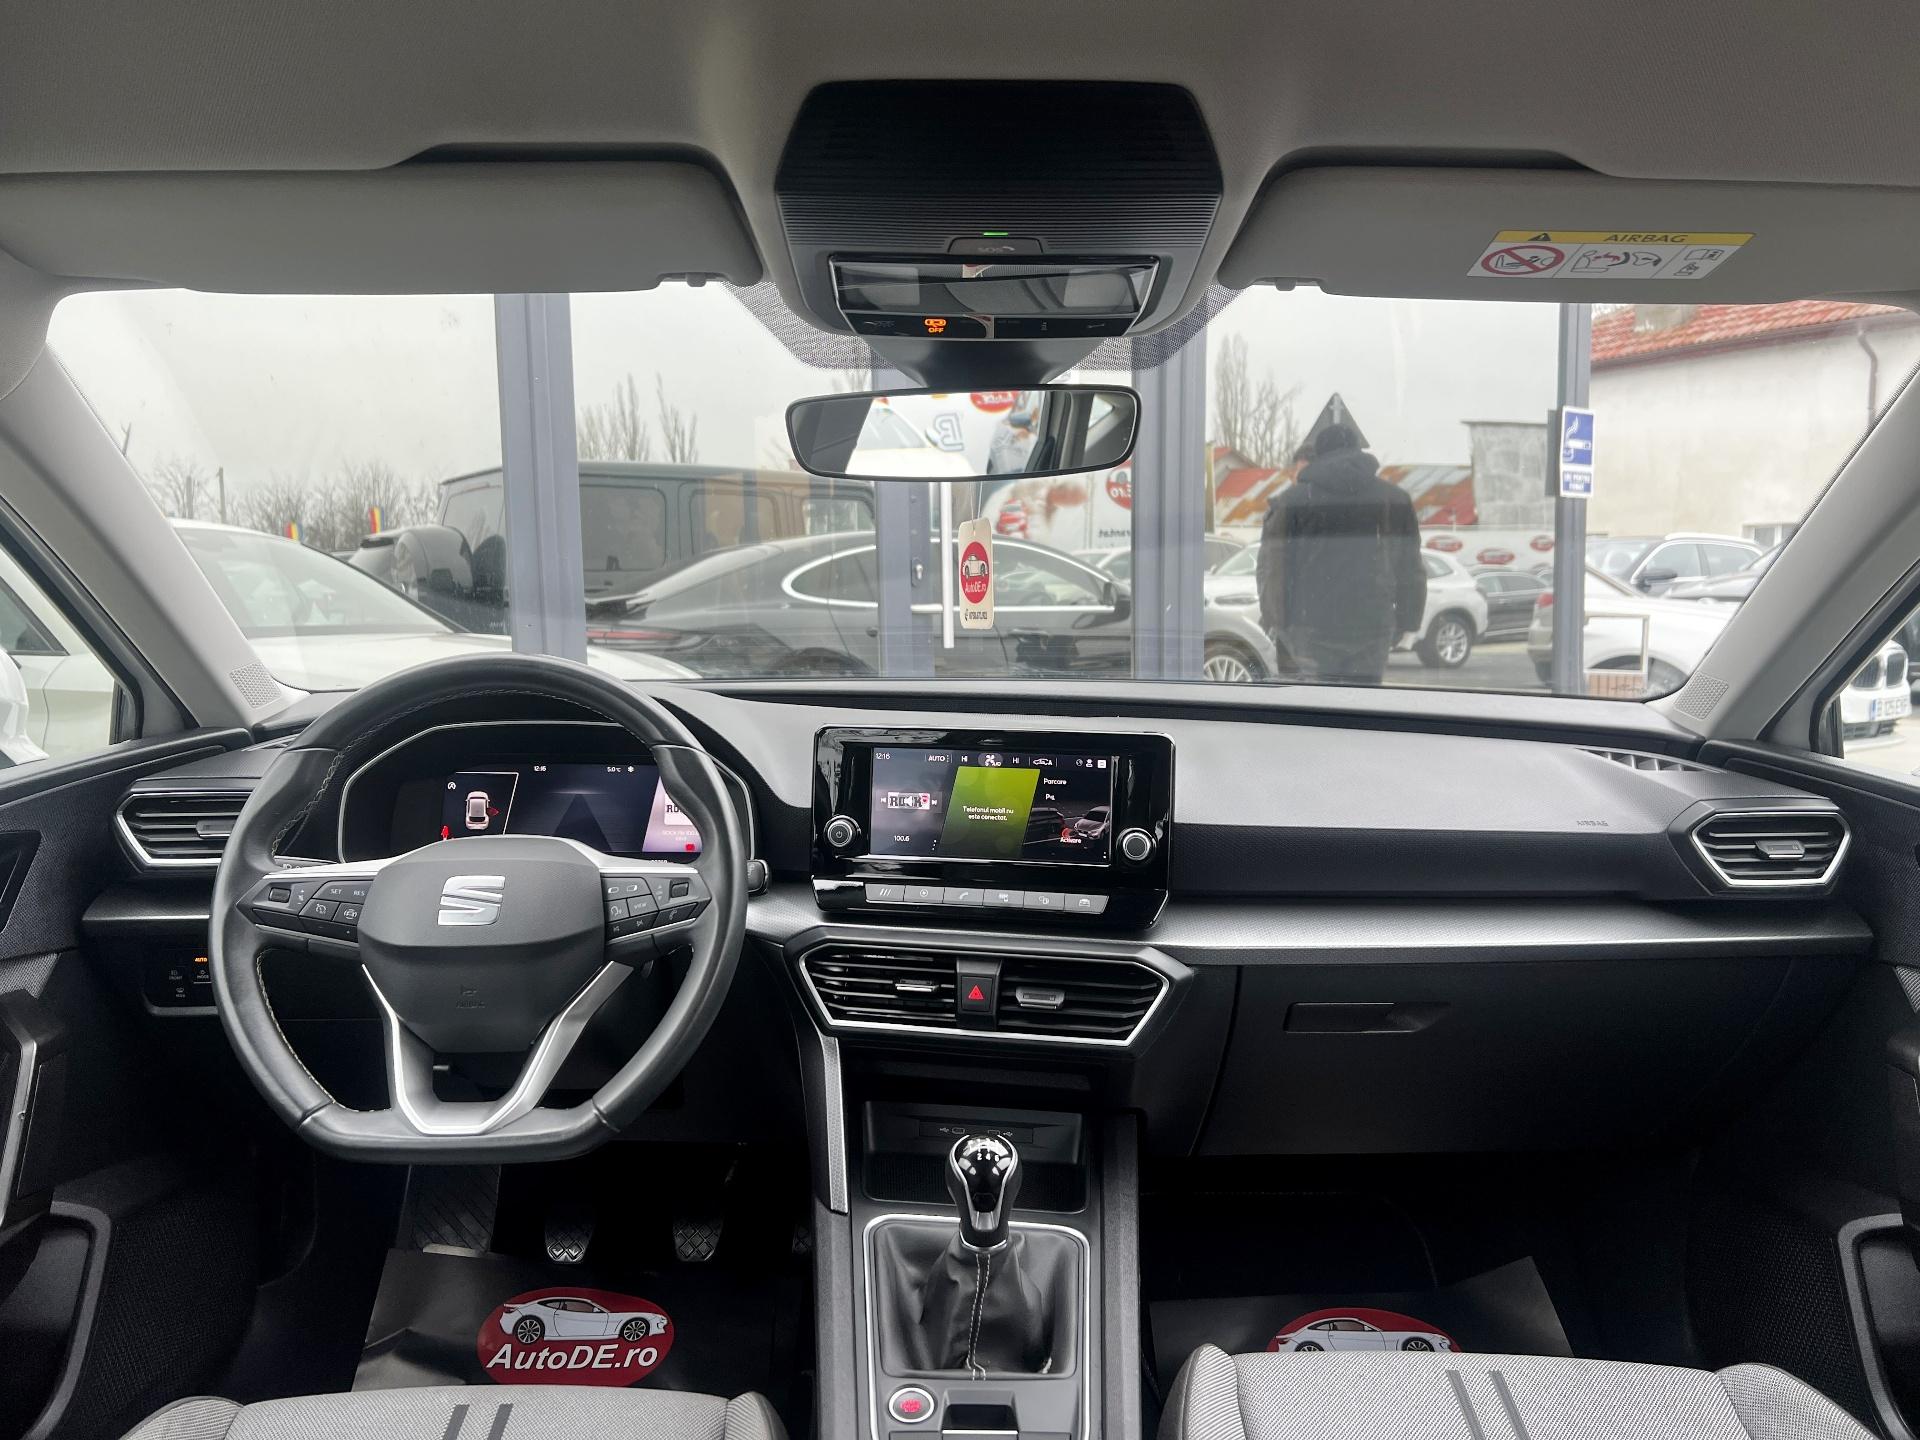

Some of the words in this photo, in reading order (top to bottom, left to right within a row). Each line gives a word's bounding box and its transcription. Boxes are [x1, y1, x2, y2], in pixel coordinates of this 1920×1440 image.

[1603, 233, 1688, 243] AIRBAG
[965, 581, 987, 593] AutoDE.ro
[876, 752, 891, 760] 12:16
[1043, 777, 1067, 785] Parcare
[963, 805, 989, 814] Telefonul
[1060, 836, 1082, 844] Activare
[977, 1152, 982, 1161] 2
[486, 1342, 658, 1371] AutoDE.ro
